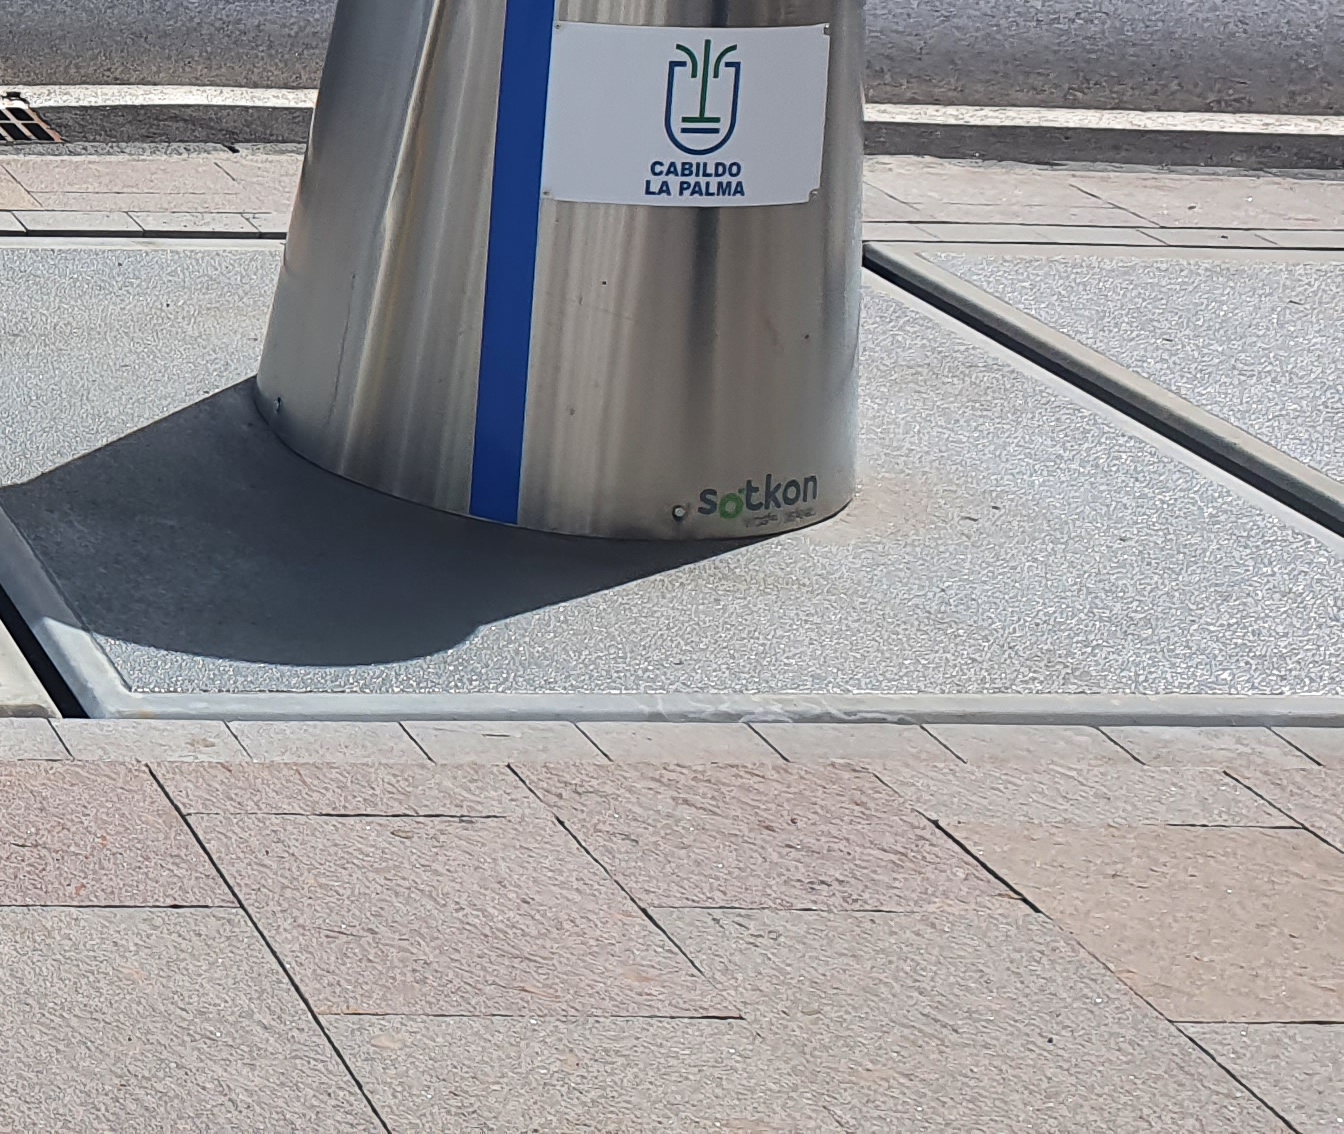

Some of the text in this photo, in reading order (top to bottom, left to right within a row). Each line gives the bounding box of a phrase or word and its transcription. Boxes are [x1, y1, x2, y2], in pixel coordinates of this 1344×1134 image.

[650, 160, 742, 178] CABILDO
[644, 179, 745, 197] LA PALMA
[698, 473, 818, 520] sotkon
